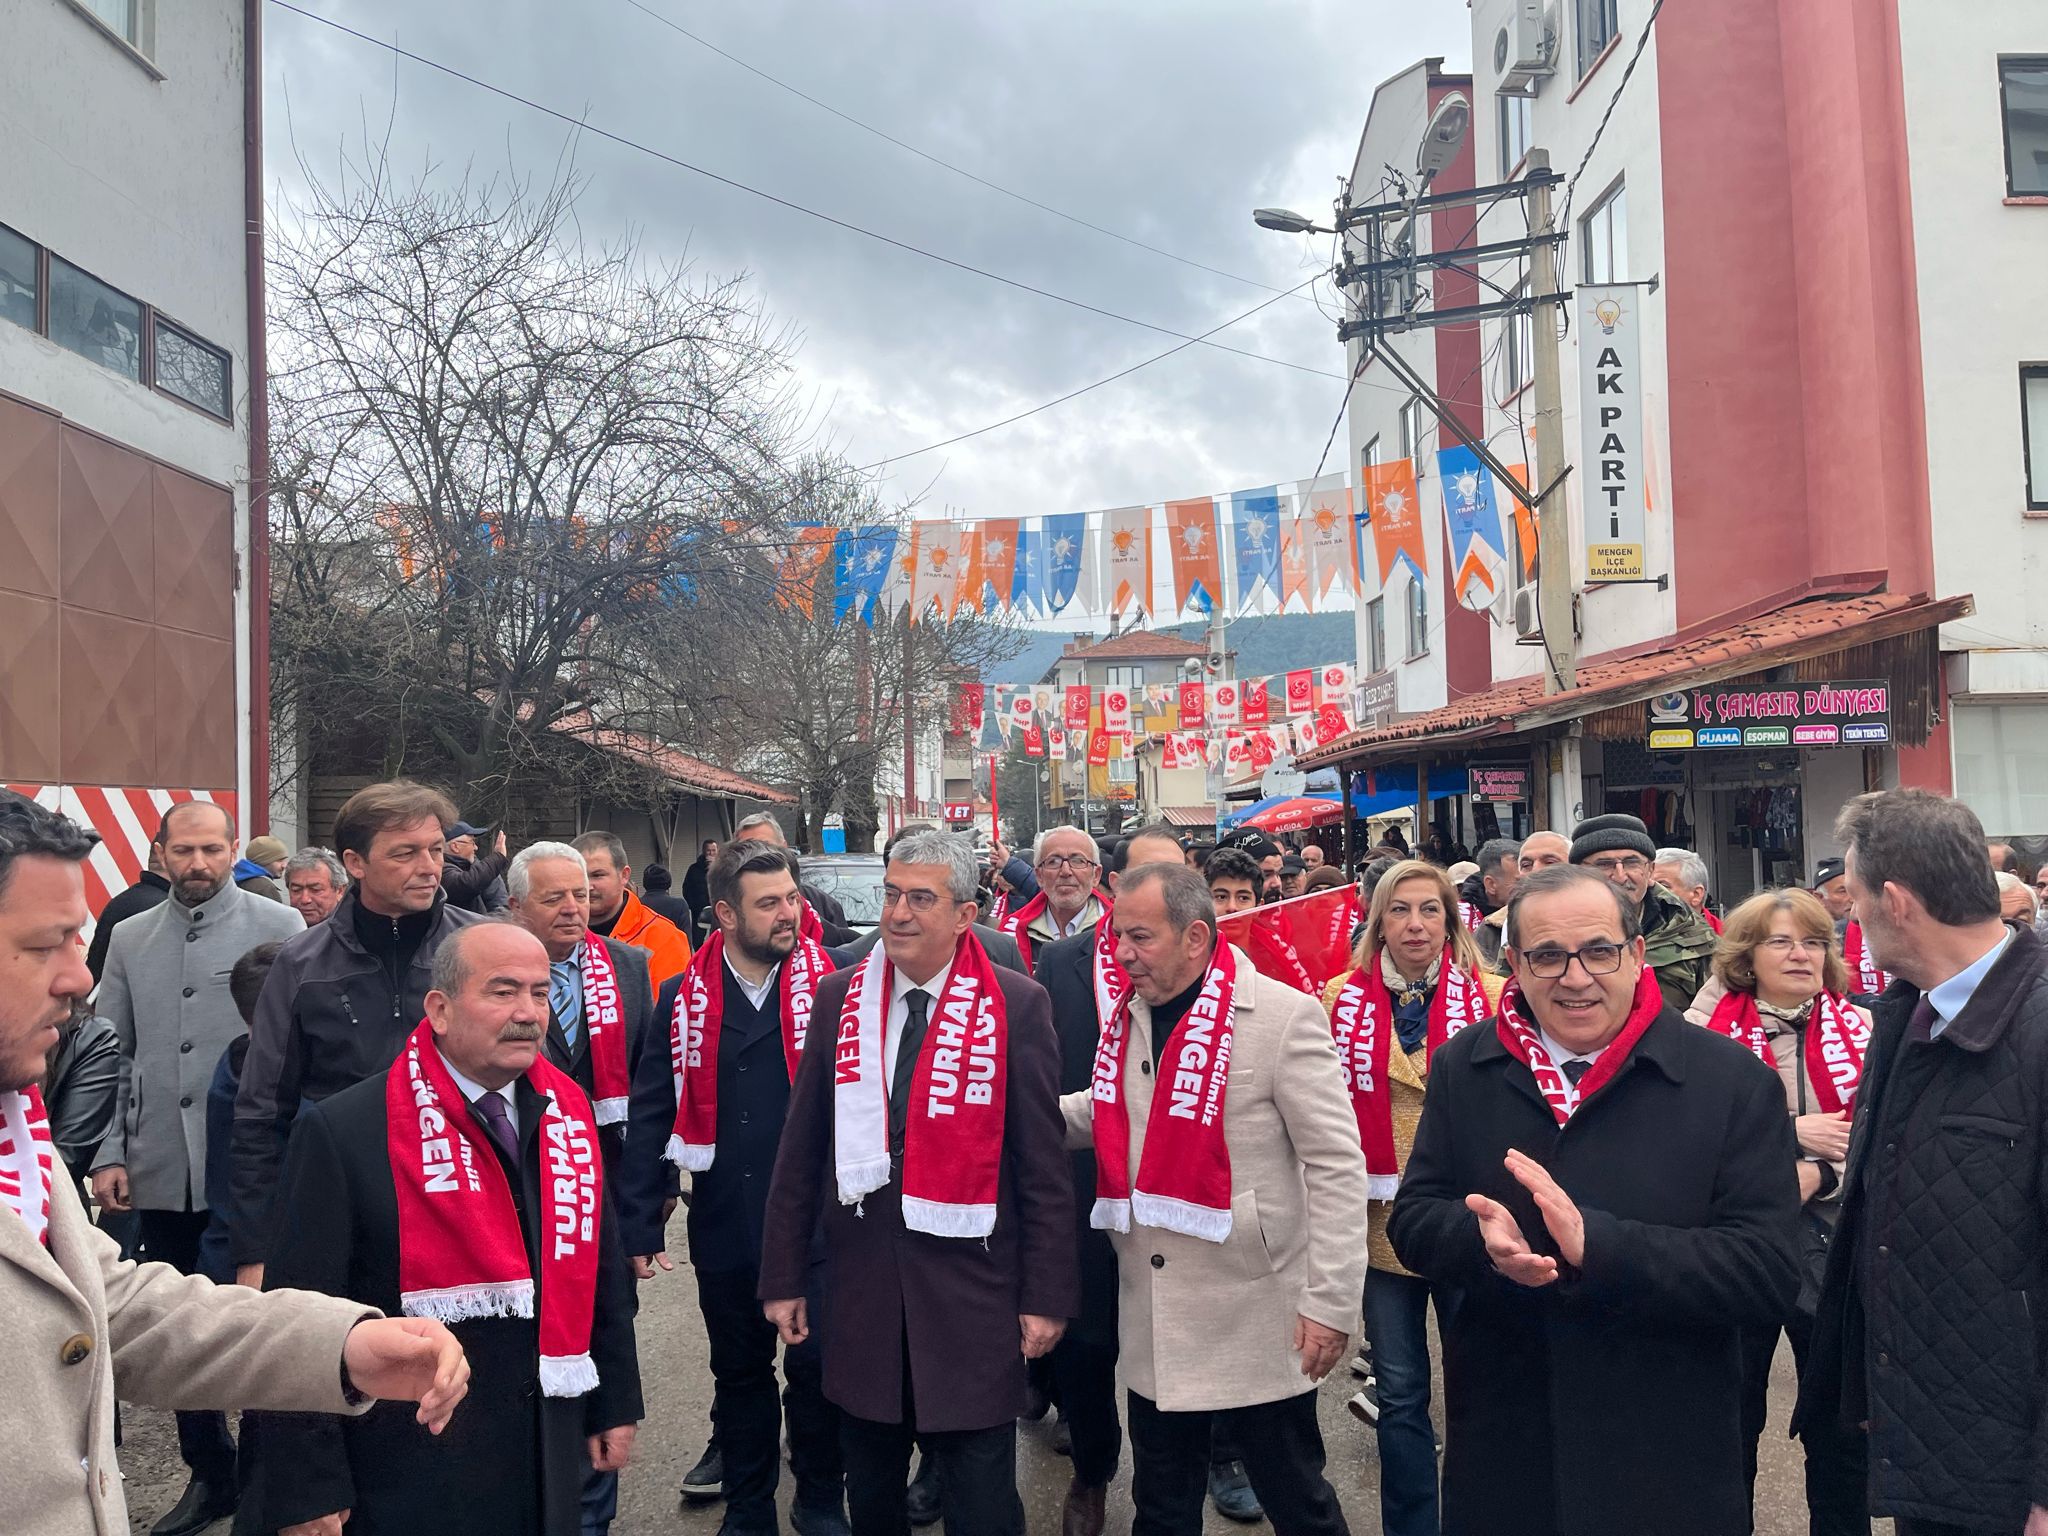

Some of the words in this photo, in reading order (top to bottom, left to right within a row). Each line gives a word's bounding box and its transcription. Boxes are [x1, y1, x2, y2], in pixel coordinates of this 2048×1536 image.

[1597, 548, 1633, 557] MENGEN
[1606, 557, 1625, 567] İLÇE
[1590, 566, 1641, 577] BAŞKANLIĞI
[1804, 685, 1886, 717] DÜNYASI
[1654, 733, 1689, 745] ÇORAP
[1700, 732, 1739, 744] PİJAMA
[1746, 731, 1786, 743] EŞOFMAN
[1796, 730, 1815, 740] BEBE
[1815, 728, 1836, 740] GİYİM
[1845, 728, 1862, 739] TEKİN
[1863, 727, 1886, 738] TEKSTİL
[1275, 822, 1302, 832] ALGIDA
[687, 975, 712, 1068] BULUT
[927, 973, 979, 1120] TURHAN
[1168, 967, 1226, 1121] MENGEN
[1353, 1002, 1376, 1093] BULUT
[965, 995, 993, 1106] BULUT
[545, 1088, 577, 1260] TURHAN
[563, 1114, 597, 1243] BULUT
